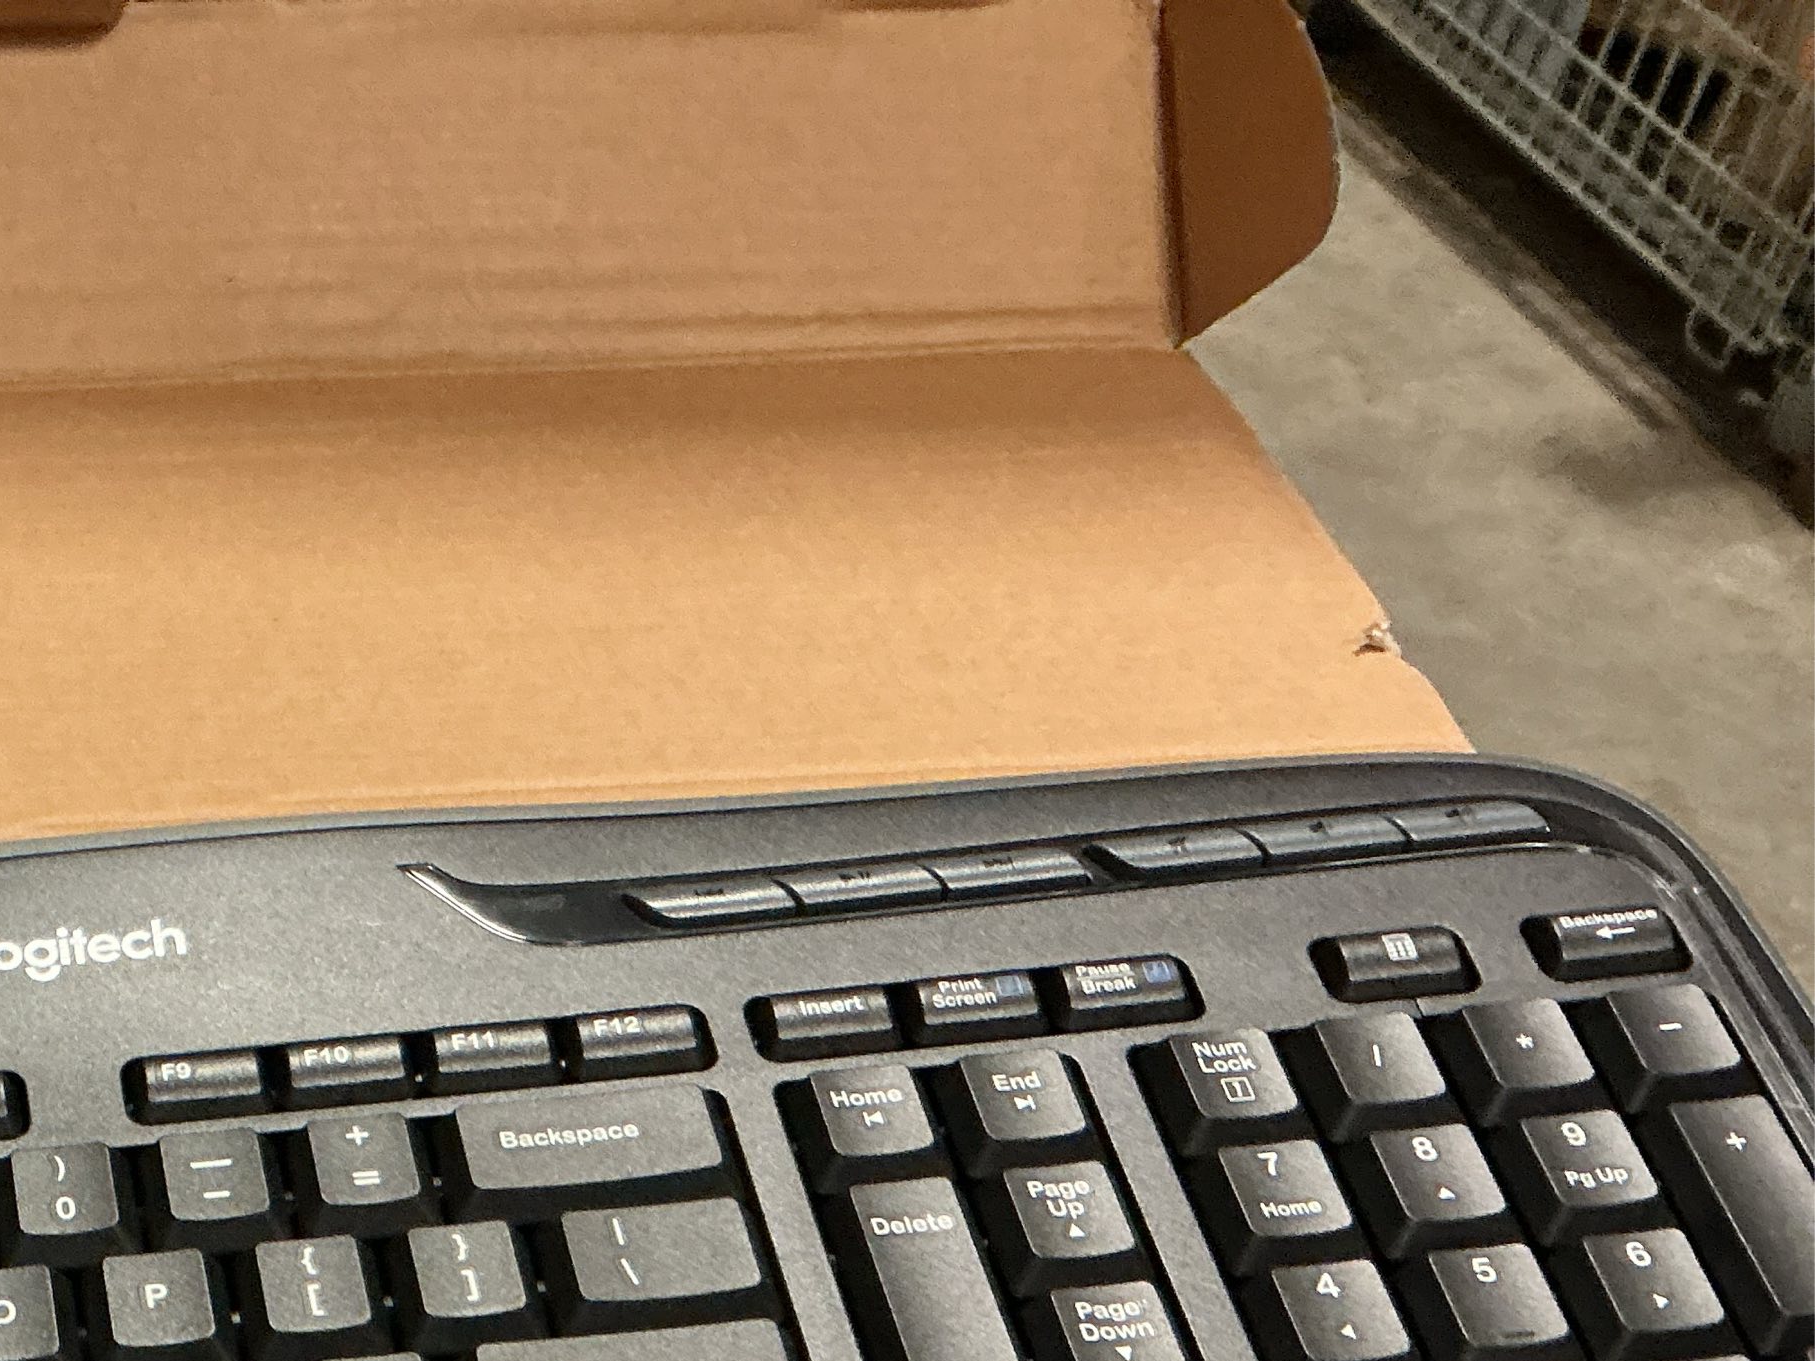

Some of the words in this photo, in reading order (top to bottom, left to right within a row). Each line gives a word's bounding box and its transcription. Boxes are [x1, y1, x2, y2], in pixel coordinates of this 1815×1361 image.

[1559, 908, 1658, 929] Backspace
[1075, 961, 1131, 978] Pause
[937, 978, 983, 994] Print
[1080, 975, 1137, 994] Break
[799, 995, 865, 1014] Insert
[932, 989, 997, 1007] Screen
[593, 1016, 642, 1038] F12
[450, 1030, 498, 1051] F11
[1193, 1040, 1248, 1059] Num
[299, 1045, 353, 1067] F10
[1202, 1053, 1257, 1074] Lock
[156, 1062, 192, 1082] F9
[992, 1070, 1042, 1091] End
[829, 1088, 904, 1108] Home
[345, 1125, 370, 1146] +
[499, 1123, 640, 1149] Backspace
[1560, 1122, 1587, 1146] 9
[1726, 1132, 1747, 1151] +
[1411, 1136, 1438, 1161] 8
[53, 1155, 66, 1182] )
[1257, 1151, 1278, 1176] 7
[351, 1170, 381, 1186] =
[1564, 1171, 1594, 1189] Pg
[1595, 1166, 1629, 1186] Up
[1027, 1180, 1090, 1200] Page
[55, 1196, 76, 1220] 0
[1046, 1198, 1085, 1220] Up
[1260, 1200, 1323, 1218] Home
[612, 1217, 625, 1246] |
[870, 1213, 954, 1235] Delete
[451, 1233, 469, 1261] }
[1625, 1241, 1652, 1267] 6
[300, 1246, 318, 1275] {
[1471, 1257, 1497, 1283] 5
[620, 1258, 640, 1286] \
[144, 1283, 168, 1309] P
[460, 1269, 480, 1302] ]
[1316, 1272, 1341, 1298] 4
[306, 1283, 325, 1317] [
[1075, 1300, 1141, 1319] Page
[1079, 1319, 1155, 1342] Down
